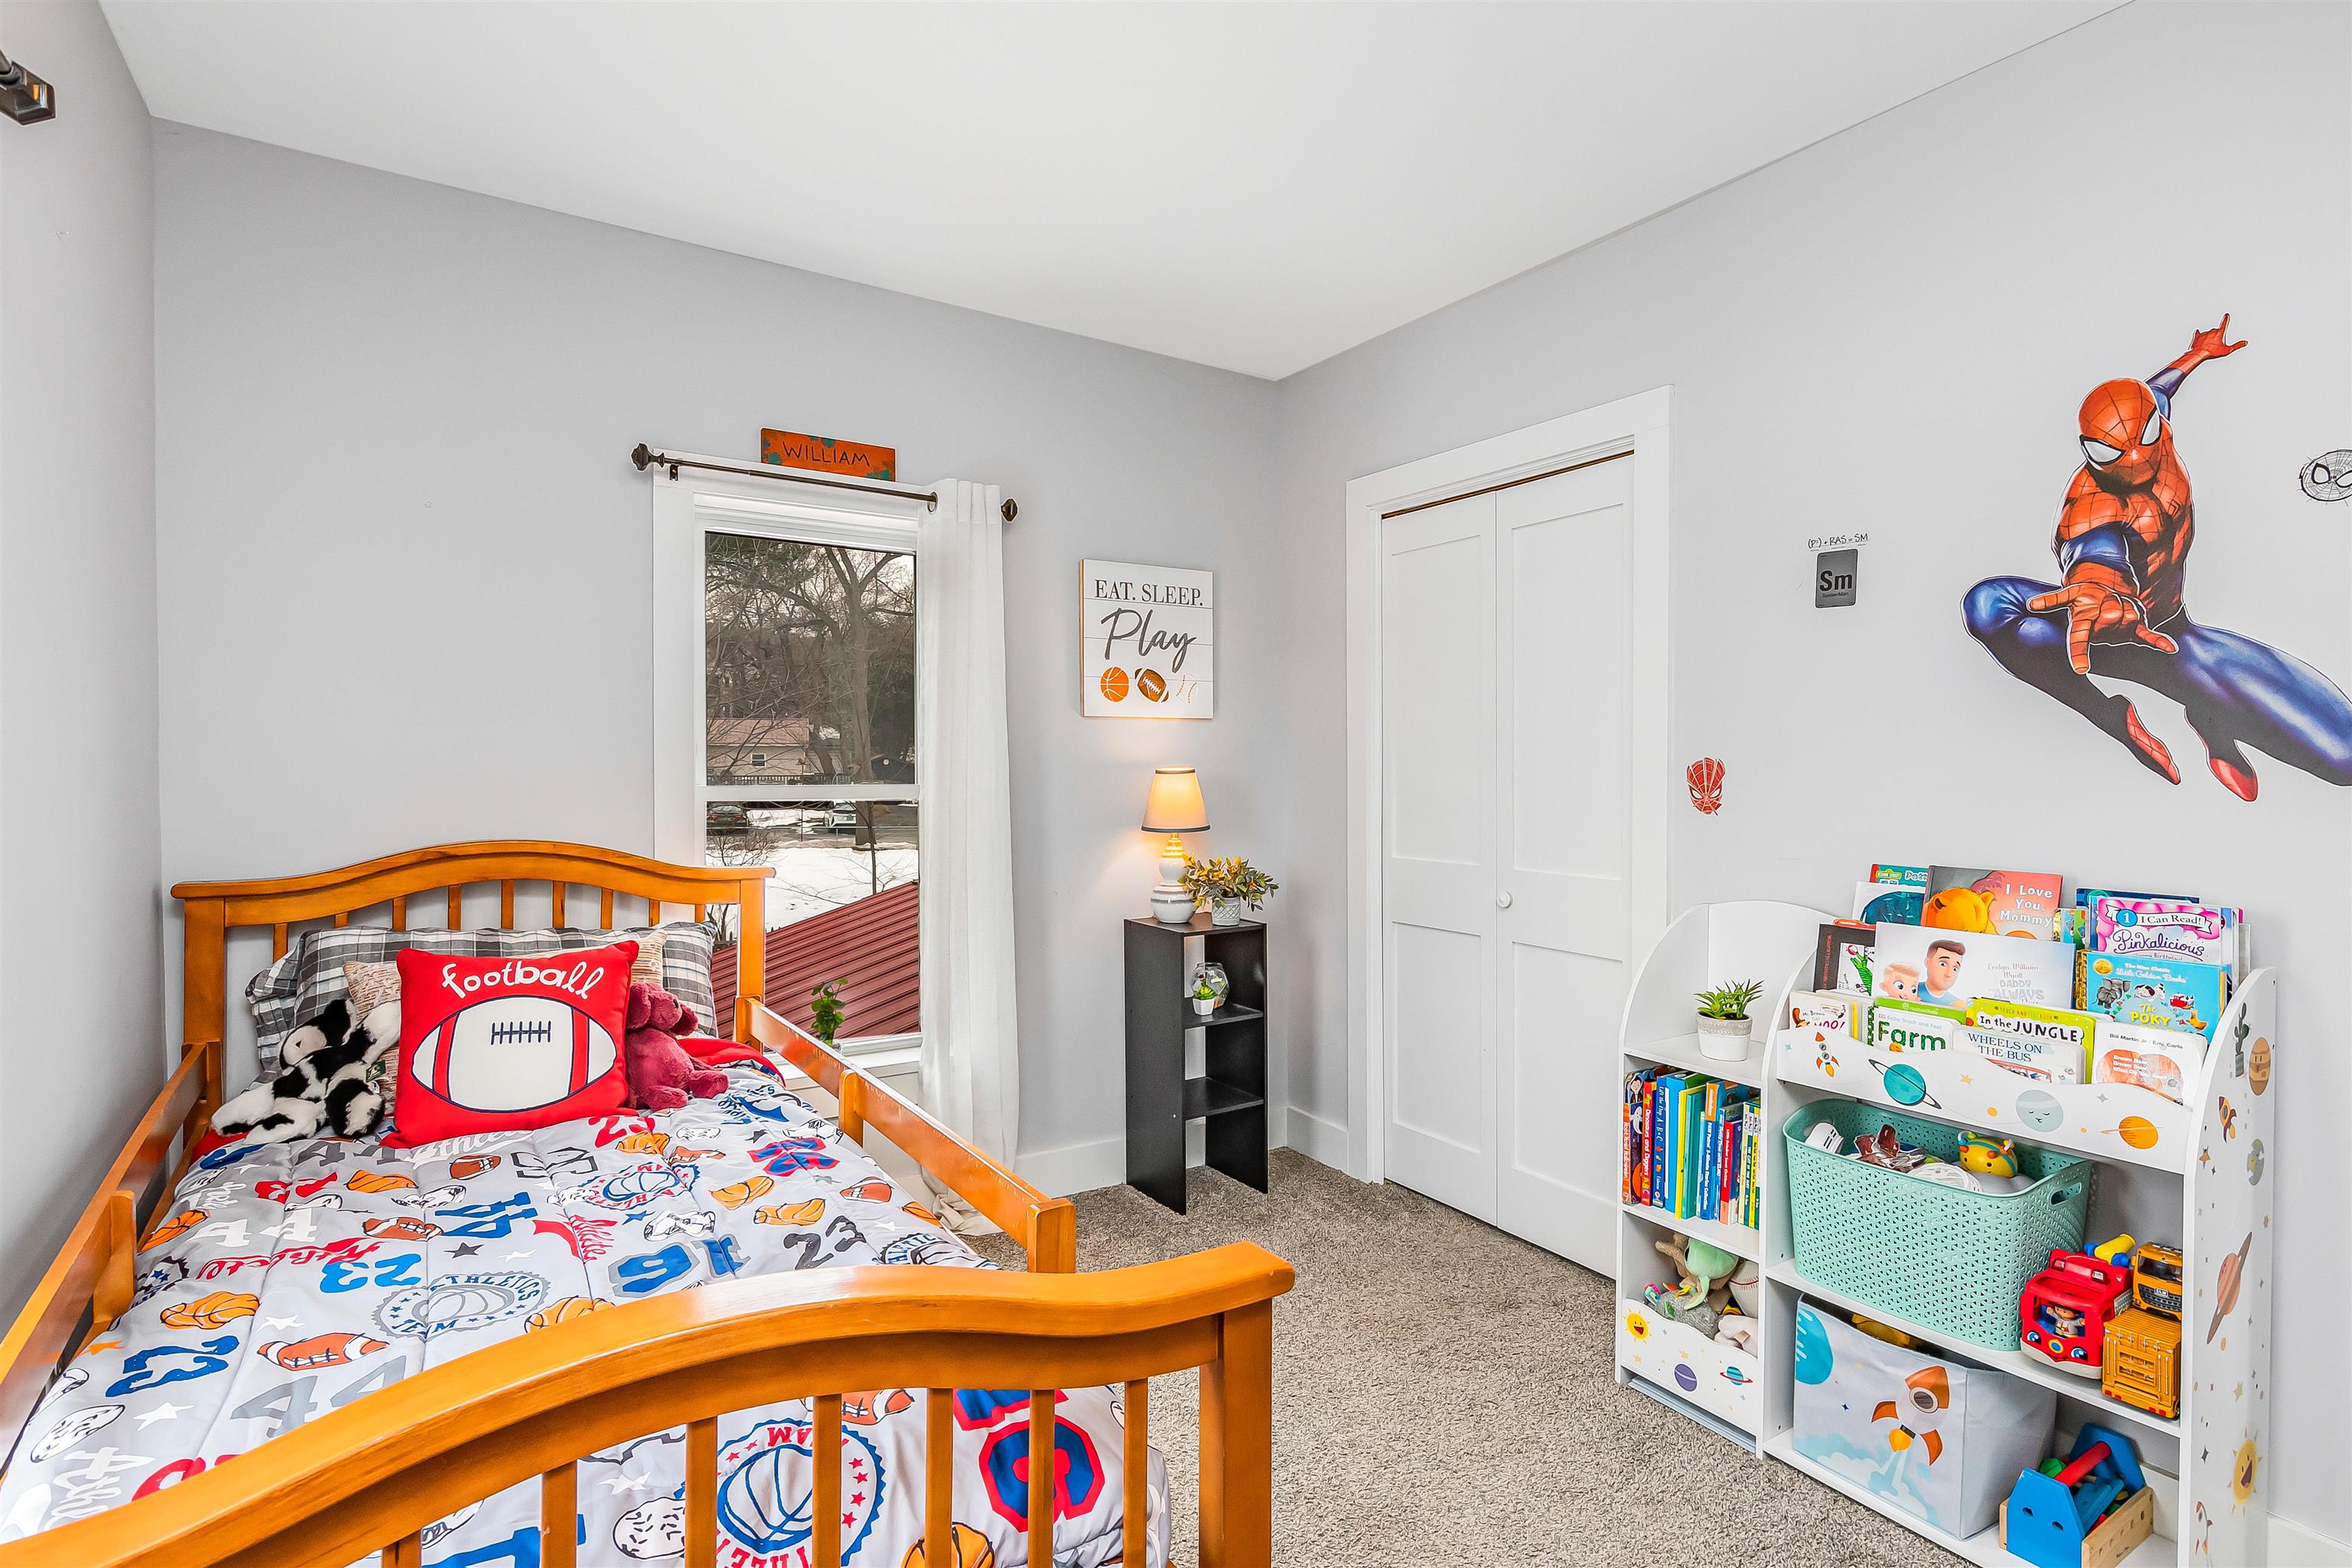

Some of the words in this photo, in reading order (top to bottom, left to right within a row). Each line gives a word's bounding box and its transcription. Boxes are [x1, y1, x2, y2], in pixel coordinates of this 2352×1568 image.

[782, 442, 870, 467] WILLIAM
[1829, 535, 1847, 546] RAS
[1854, 533, 1868, 543] SM
[1819, 570, 1853, 592] Sm
[1095, 580, 1136, 601] EAT.
[1142, 583, 1203, 606] SLEEP.
[1100, 607, 1197, 674] Play
[2006, 884, 2011, 895] I
[2019, 885, 2053, 898] Love
[2000, 910, 2053, 927] Mommy
[2123, 913, 2130, 923] 1
[2147, 916, 2168, 924] Can
[2171, 915, 2201, 925] Read!
[2112, 929, 2205, 956] Pinkalicious
[441, 960, 605, 999] football
[2000, 980, 2031, 988] DADDY
[2130, 1011, 2172, 1026] POKY
[2139, 1004, 2156, 1012] The
[1878, 1021, 1946, 1051] Farm
[1980, 1016, 1991, 1024] In
[1994, 1018, 2011, 1027] the
[2013, 1021, 2077, 1042] JUNGLE
[1968, 1033, 2021, 1050] WHEELS
[2024, 1044, 2042, 1054] ON
[1978, 1045, 2004, 1057] THE
[2007, 1050, 2031, 1062] BUS
